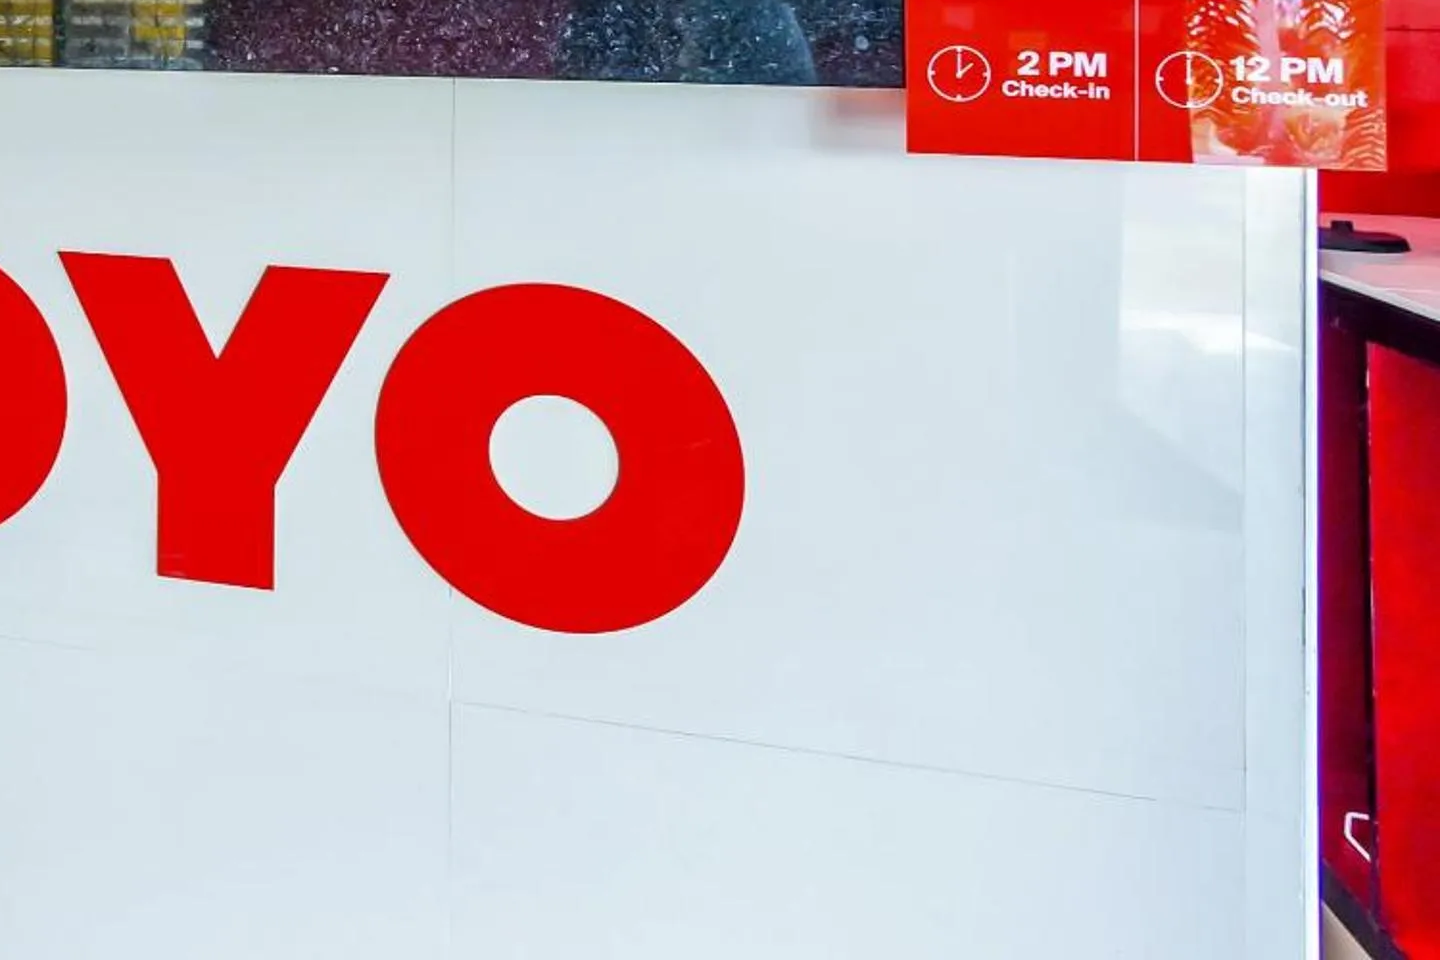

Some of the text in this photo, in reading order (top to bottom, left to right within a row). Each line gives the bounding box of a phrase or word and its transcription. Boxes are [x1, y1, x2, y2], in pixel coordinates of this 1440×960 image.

[1016, 50, 1107, 78] 2 PM
[1229, 54, 1344, 84] 12 PM
[1001, 79, 1111, 101] Check-in
[1231, 86, 1369, 107] Check-out
